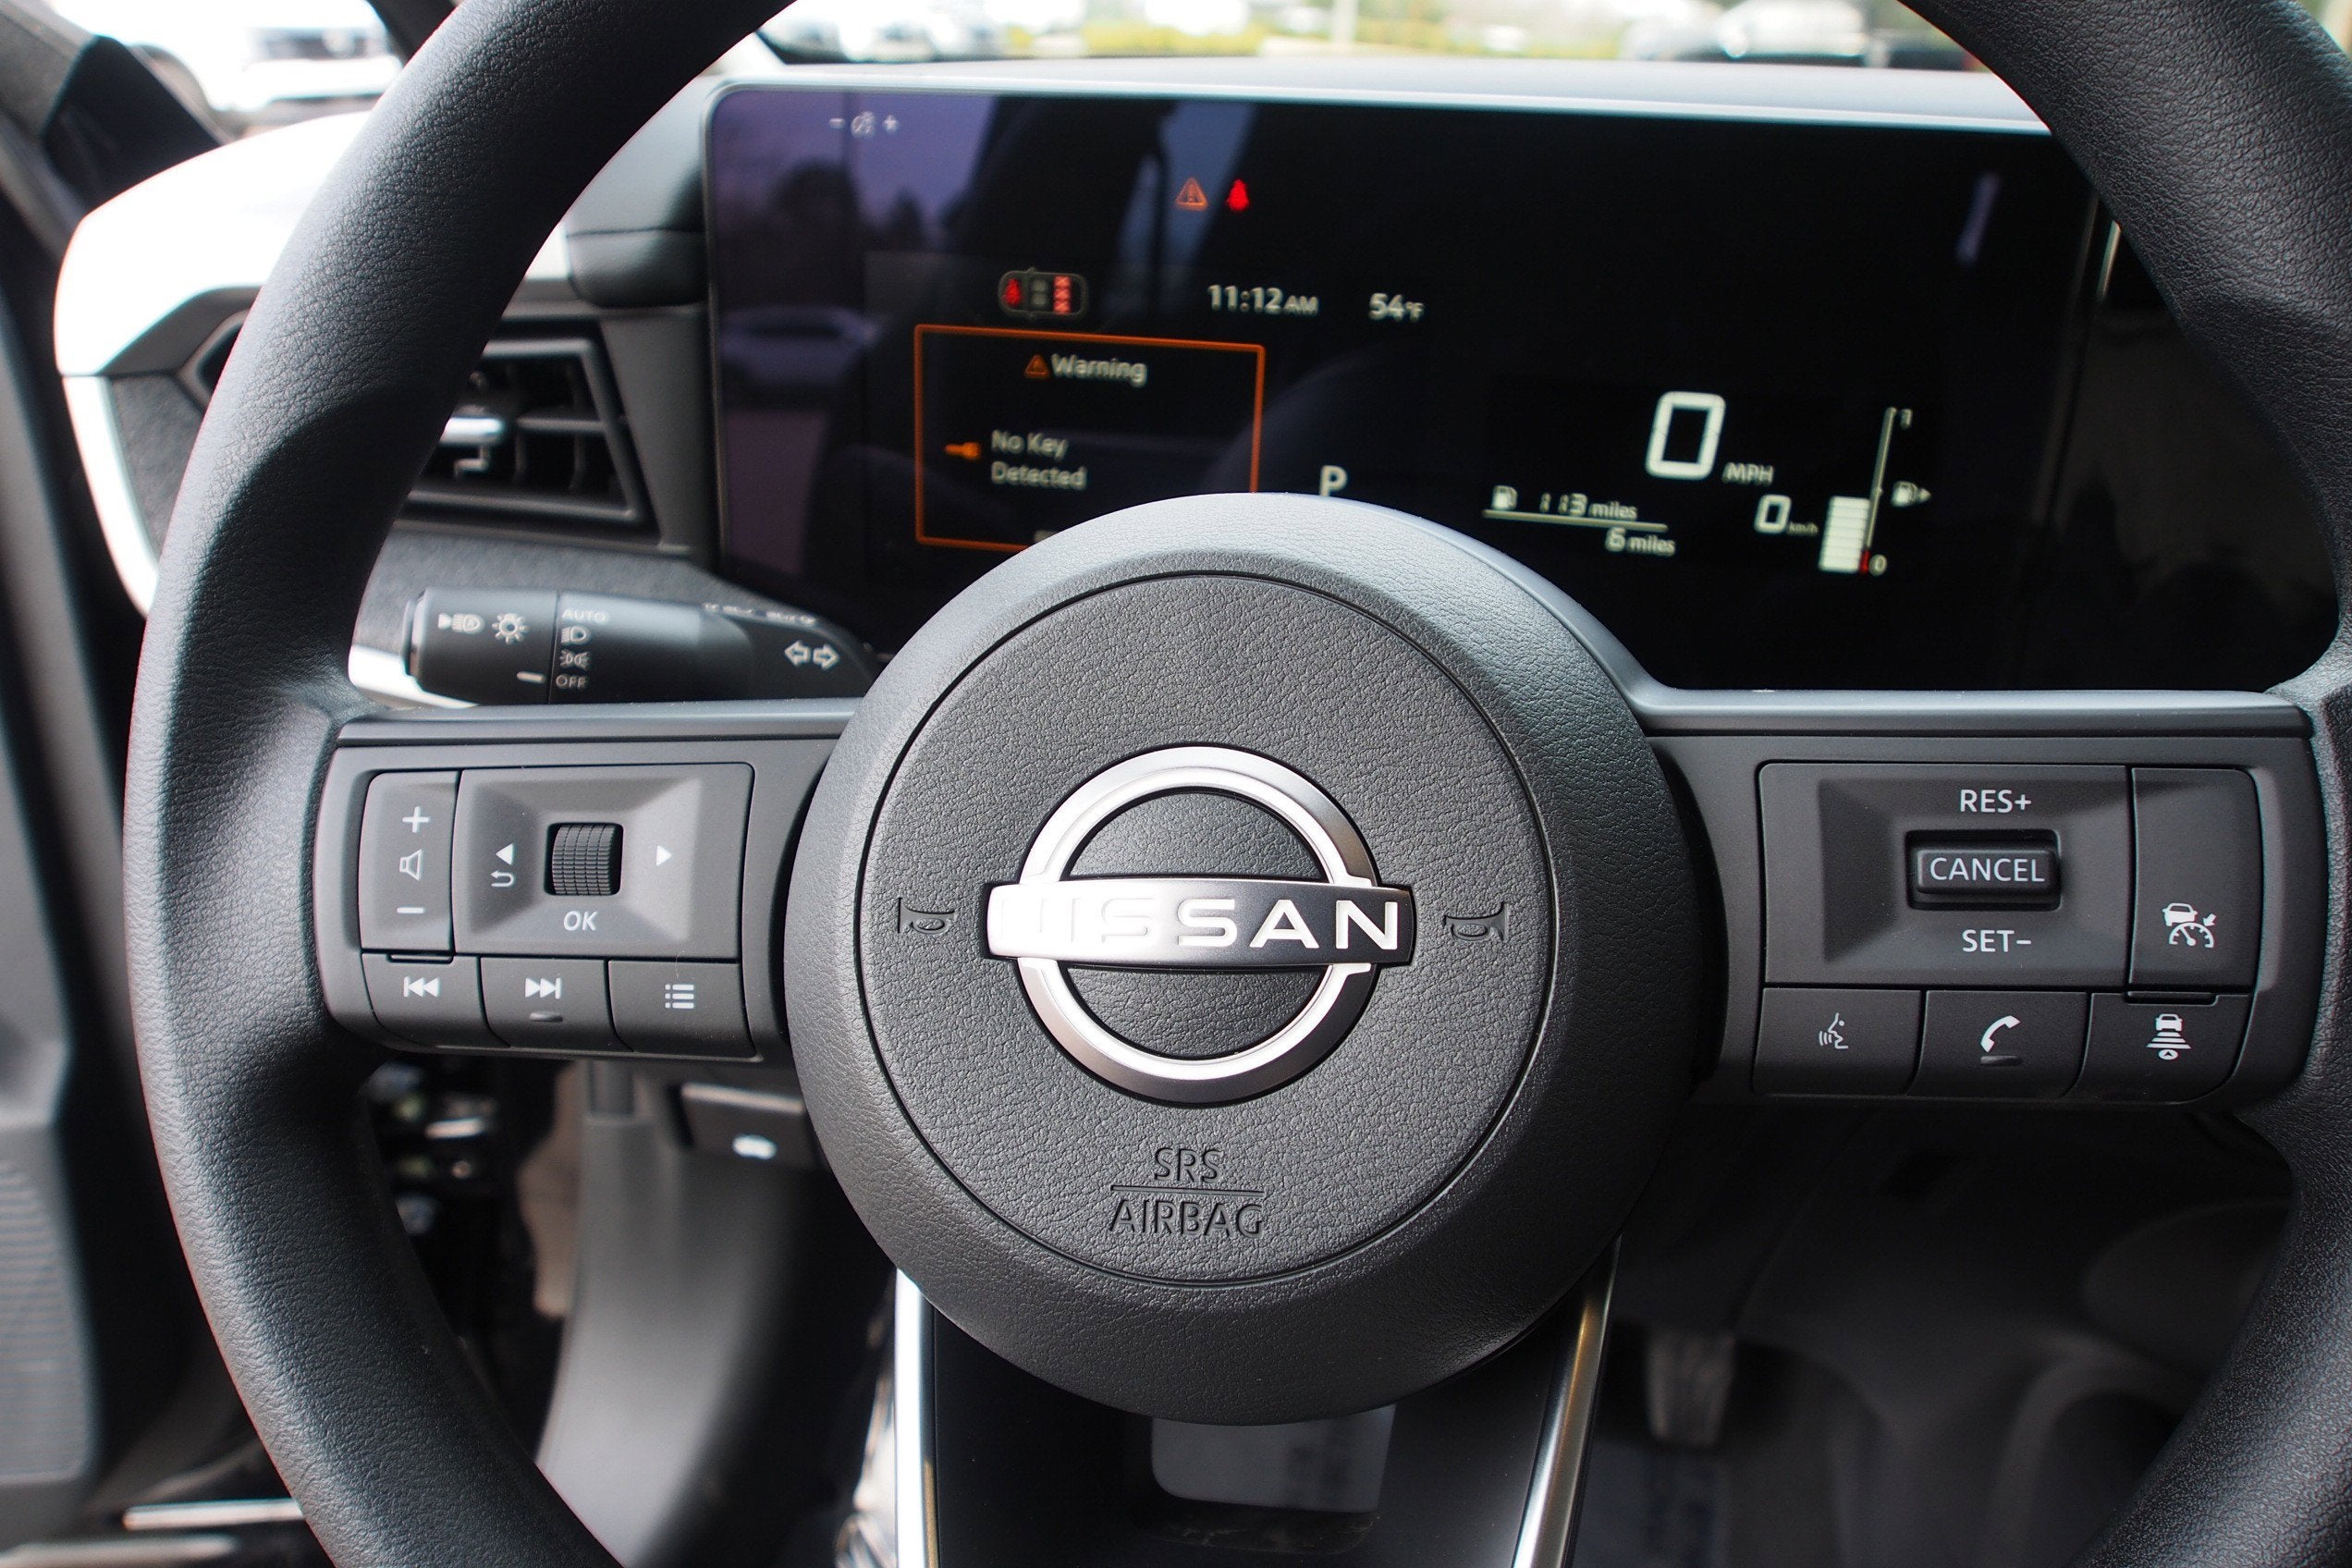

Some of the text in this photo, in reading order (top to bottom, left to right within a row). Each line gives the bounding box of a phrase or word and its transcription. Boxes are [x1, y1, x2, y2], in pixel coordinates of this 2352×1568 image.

[1050, 352, 1147, 387] Warning
[991, 430, 1068, 460] No Key
[1645, 391, 1773, 485] 0 MPH
[991, 461, 1087, 490] Detected
[1319, 464, 1347, 497] P
[1539, 492, 1637, 521] 113 miles
[1754, 494, 1791, 534] 0
[1627, 535, 1675, 556] miles
[560, 608, 607, 624] AUTO
[555, 674, 588, 690] OFF
[1959, 789, 2032, 814] RES+
[1929, 857, 2045, 884] CANCEL
[562, 911, 598, 932] OK
[1154, 1148, 1223, 1182] SRS
[1110, 1200, 1264, 1239] AIRBAG
